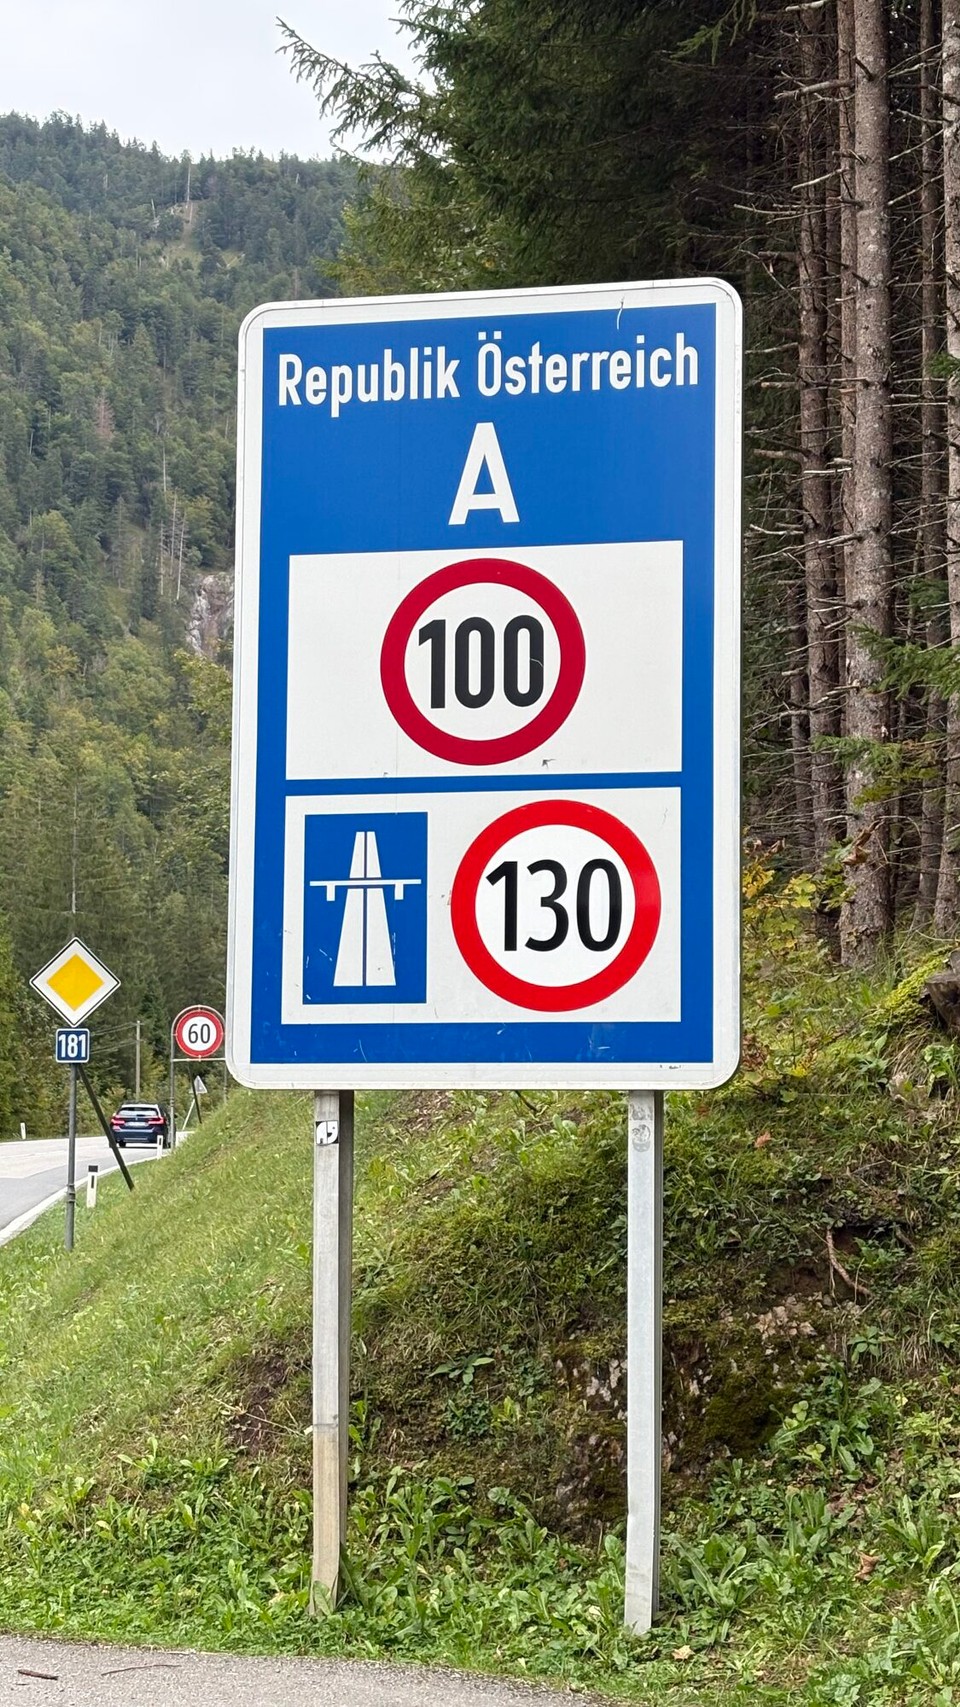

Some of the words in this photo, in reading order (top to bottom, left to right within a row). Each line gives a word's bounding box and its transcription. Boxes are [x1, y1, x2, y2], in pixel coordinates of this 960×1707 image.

[278, 346, 460, 418] Republik
[477, 331, 699, 397] Österreich
[448, 422, 520, 526] A
[418, 614, 545, 709] 100
[485, 858, 622, 952] 130
[58, 1033, 87, 1058] 181
[187, 1023, 211, 1044] 60
